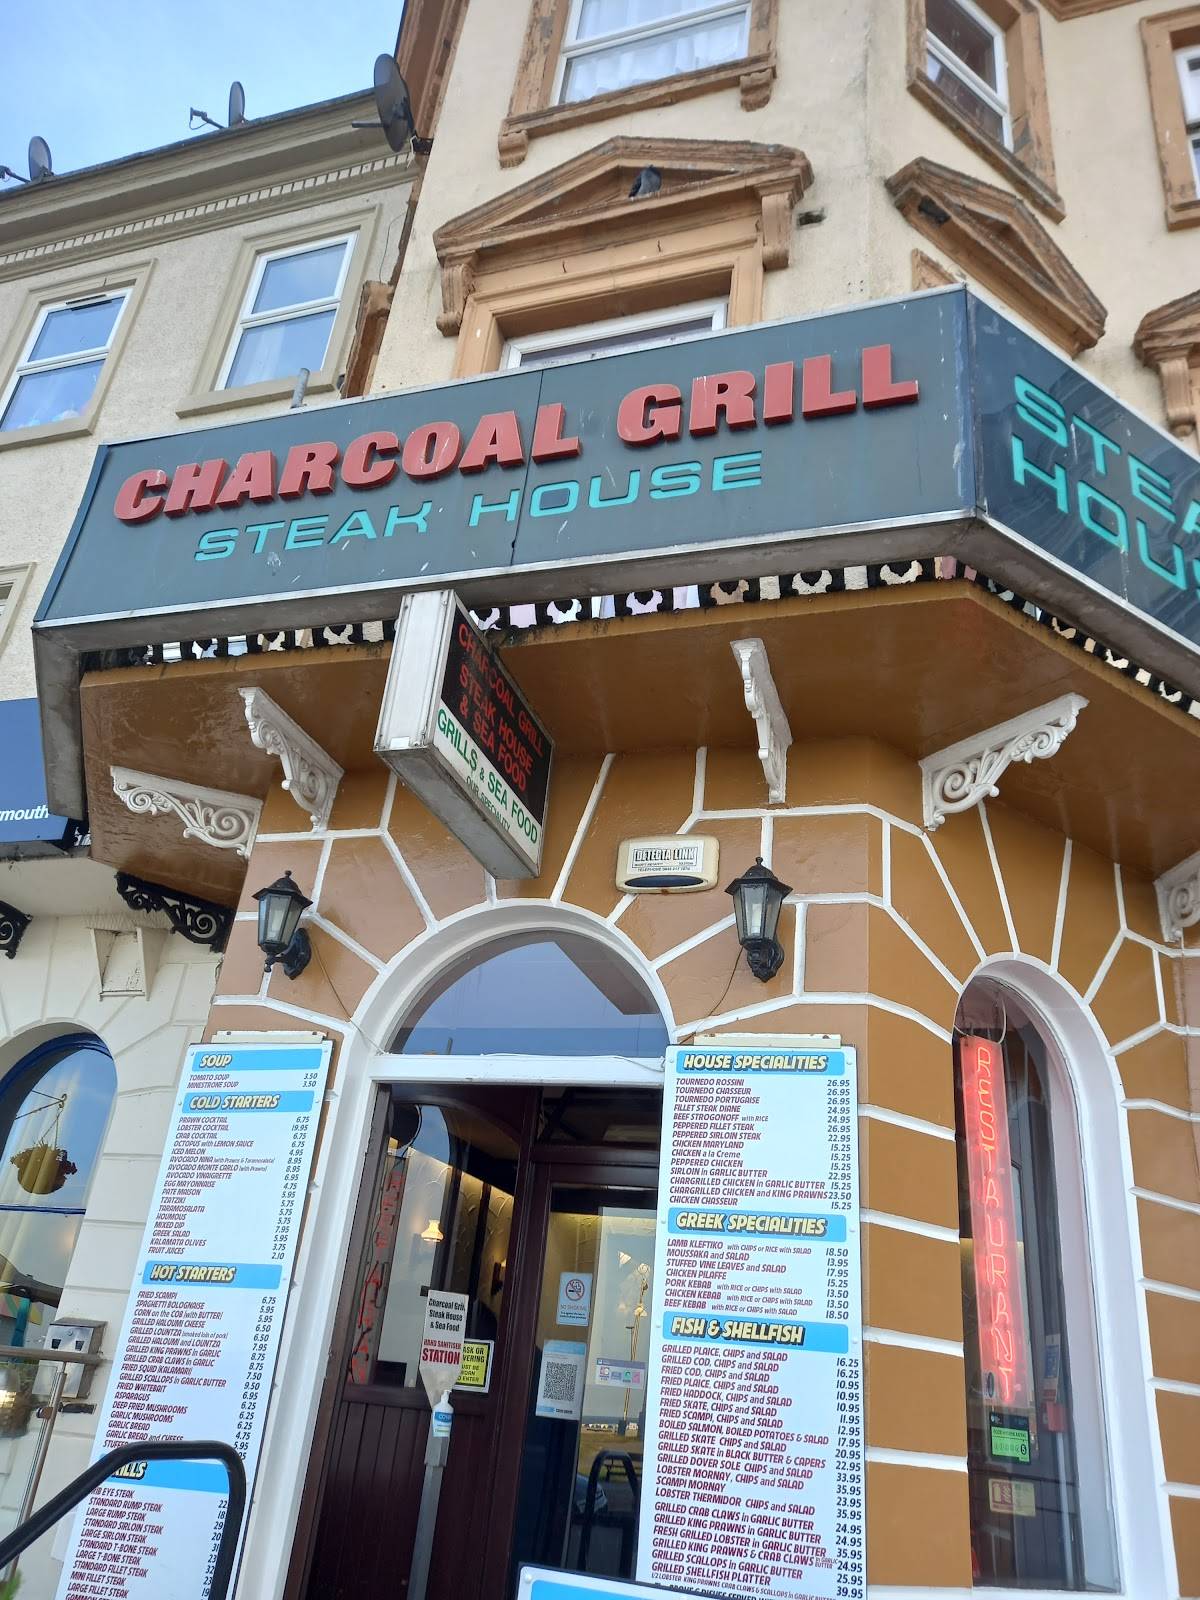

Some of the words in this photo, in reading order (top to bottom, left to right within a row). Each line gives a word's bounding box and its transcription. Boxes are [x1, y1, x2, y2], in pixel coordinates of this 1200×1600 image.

[114, 403, 580, 523] CHARCOAL
[617, 344, 919, 446] GRILL
[194, 500, 432, 562] STEAK
[470, 450, 763, 527] HOUSE
[458, 623, 515, 718] CHARCOAL
[518, 711, 544, 757] GRILL
[459, 664, 496, 726] STEAK
[499, 716, 534, 775] HOUSE
[459, 696, 468, 719] &
[473, 717, 495, 752] SEA
[497, 744, 527, 792] FOOD
[437, 709, 477, 771] GRILLS
[479, 767, 485, 780] &
[488, 775, 508, 810] SEA
[512, 799, 538, 844] FOOD
[466, 776, 480, 802] OUR
[635, 849, 671, 861] DETECTA
[672, 848, 695, 860] LINK
[199, 1054, 232, 1069] SOUP
[683, 1053, 732, 1071] HOUSE
[733, 1054, 828, 1073] SPECIALITIES
[676, 1077, 714, 1085] TOURNEDO
[189, 1096, 221, 1110] COLD
[221, 1094, 281, 1109] STARTERS
[714, 1095, 759, 1103] PORTUGAISE
[827, 1097, 850, 1105] 26.95
[673, 1112, 690, 1120] BEEF
[690, 1113, 739, 1121] STROGONOFF
[827, 1115, 850, 1123] 24.95
[672, 1130, 708, 1138] PEPPERED
[708, 1131, 737, 1139] SIRLOIN
[738, 1132, 761, 1140] STEAK
[827, 1134, 850, 1142] 22.95
[288, 1148, 303, 1156] 4.95
[671, 1148, 701, 1156] CHICKEN
[707, 1149, 714, 1157] la
[716, 1149, 740, 1158] Creme
[830, 1152, 850, 1161] 15.25
[669, 1195, 700, 1203] CHICKEN
[700, 1196, 737, 1205] CHASSEUR
[831, 1201, 851, 1209] 15.25
[675, 1211, 725, 1231] GREEK
[727, 1213, 828, 1237] SPECIALITIES
[974, 1044, 1016, 1404] RESTAURANT
[149, 1237, 184, 1245] KALAMATA
[184, 1238, 206, 1246] OLIVES
[666, 1248, 708, 1258] MOUSSAKA
[709, 1251, 724, 1259] and
[724, 1251, 749, 1260] SALAD
[827, 1257, 848, 1267] 13.95
[150, 1265, 178, 1281] HOT
[177, 1267, 236, 1284] STARTERS
[666, 1258, 697, 1267] STUFFED
[699, 1260, 716, 1269] VINE
[716, 1261, 745, 1270] LEAVES
[745, 1263, 760, 1271] and
[761, 1264, 786, 1273] SALAD
[826, 1268, 848, 1277] 17.95
[665, 1268, 697, 1277] CHICKEN
[697, 1270, 726, 1279] PILAFFE
[827, 1278, 848, 1287] 15.25
[135, 1299, 167, 1307] SPAGHETTI
[166, 1300, 204, 1309] BOLOGNAISE
[259, 1305, 274, 1313] 5.95
[428, 1298, 453, 1310] Charcoal
[429, 1309, 445, 1320] Steak
[446, 1311, 462, 1322] House
[435, 1320, 446, 1331] Sea
[446, 1321, 459, 1332] Food
[671, 1316, 706, 1337] FISH
[707, 1318, 721, 1338] &
[722, 1320, 806, 1345] SHELLFISH
[422, 1349, 461, 1365] STATION
[463, 1346, 474, 1354] ASK
[475, 1347, 484, 1355] OR
[463, 1354, 485, 1363] VERING
[116, 1381, 134, 1390] FRIED
[134, 1383, 166, 1392] WHITEBAIT
[242, 1391, 258, 1400] 6.95
[660, 1386, 682, 1396] FRIED
[683, 1388, 723, 1401] HADDOCK,
[725, 1392, 748, 1402] CHIPS
[749, 1395, 765, 1404] and
[765, 1396, 792, 1406] SALAD
[836, 1402, 859, 1412] 10.95
[114, 1391, 150, 1401] ASPARAGUS
[240, 1401, 256, 1410] 6.25
[110, 1410, 132, 1419] GARLIC
[131, 1412, 173, 1422] MUSHROOMS
[237, 1420, 252, 1430] 6.25
[658, 1419, 686, 1429] BOILED
[687, 1422, 723, 1434] SALMON,
[725, 1426, 752, 1436] BOILED
[753, 1429, 794, 1441] POTATOES
[795, 1433, 802, 1442] &
[803, 1434, 828, 1444] SALAD
[837, 1437, 860, 1448] 17.95
[112, 1462, 147, 1480] ILLS
[655, 1475, 687, 1487] SCAMPI
[687, 1479, 726, 1492] MORNAY
[836, 1496, 861, 1508] 23.95
[83, 1517, 117, 1528] STANDARD
[117, 1521, 143, 1532] SIRLOIN
[142, 1524, 163, 1534] STEAK
[75, 1549, 97, 1559] LARGE
[96, 1551, 121, 1562] T-BONE
[120, 1554, 141, 1565] STEAK
[651, 1561, 684, 1576] GRILLED
[685, 1566, 730, 1580] SHELLFISH
[731, 1571, 770, 1585] PLATTER
[836, 1585, 863, 1598] 39.95
